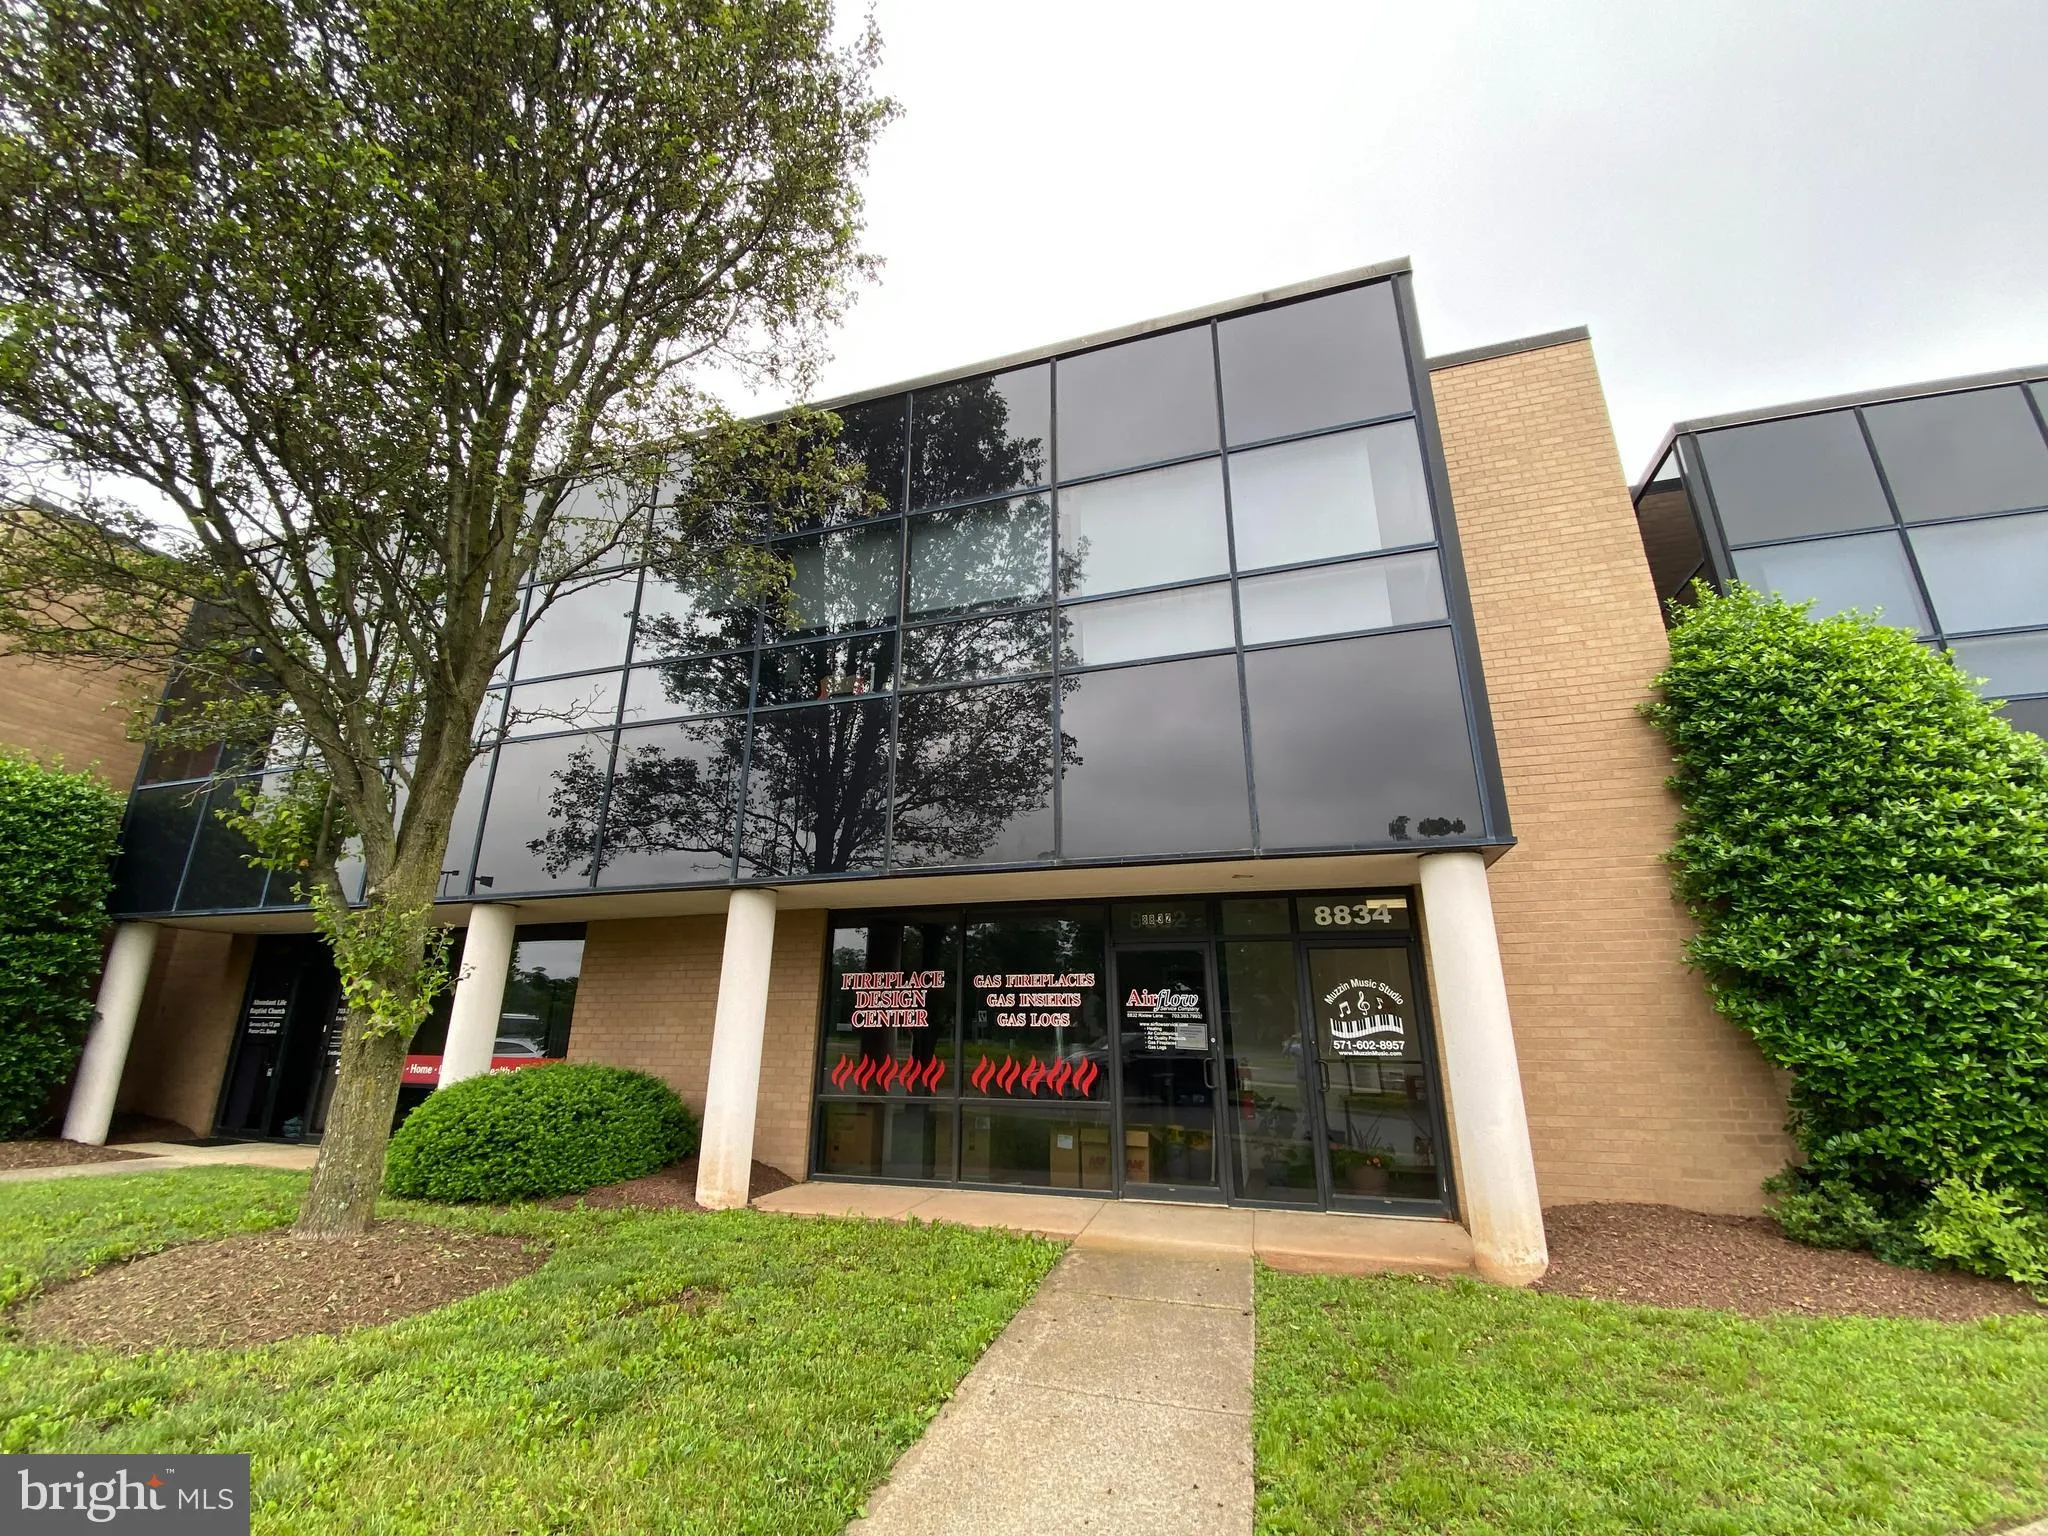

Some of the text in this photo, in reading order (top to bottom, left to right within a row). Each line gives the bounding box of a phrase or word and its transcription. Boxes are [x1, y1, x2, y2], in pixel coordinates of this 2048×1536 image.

[1314, 904, 1392, 926] 8834
[841, 970, 945, 990] FIREPLACE
[973, 973, 1095, 988] GAS FIREPLACES
[855, 990, 927, 1009] DESIGN
[986, 993, 1081, 1007] GAS INSERTS
[1126, 989, 1199, 1012] Airflow
[1324, 979, 1404, 1005] Muzzin Music Studio
[851, 1009, 929, 1028] CENTER
[997, 1013, 1071, 1027] GAS LOGS
[1333, 1040, 1405, 1050] 571-602-8957
[410, 1063, 432, 1075] Home
[490, 1065, 510, 1076] ealth
